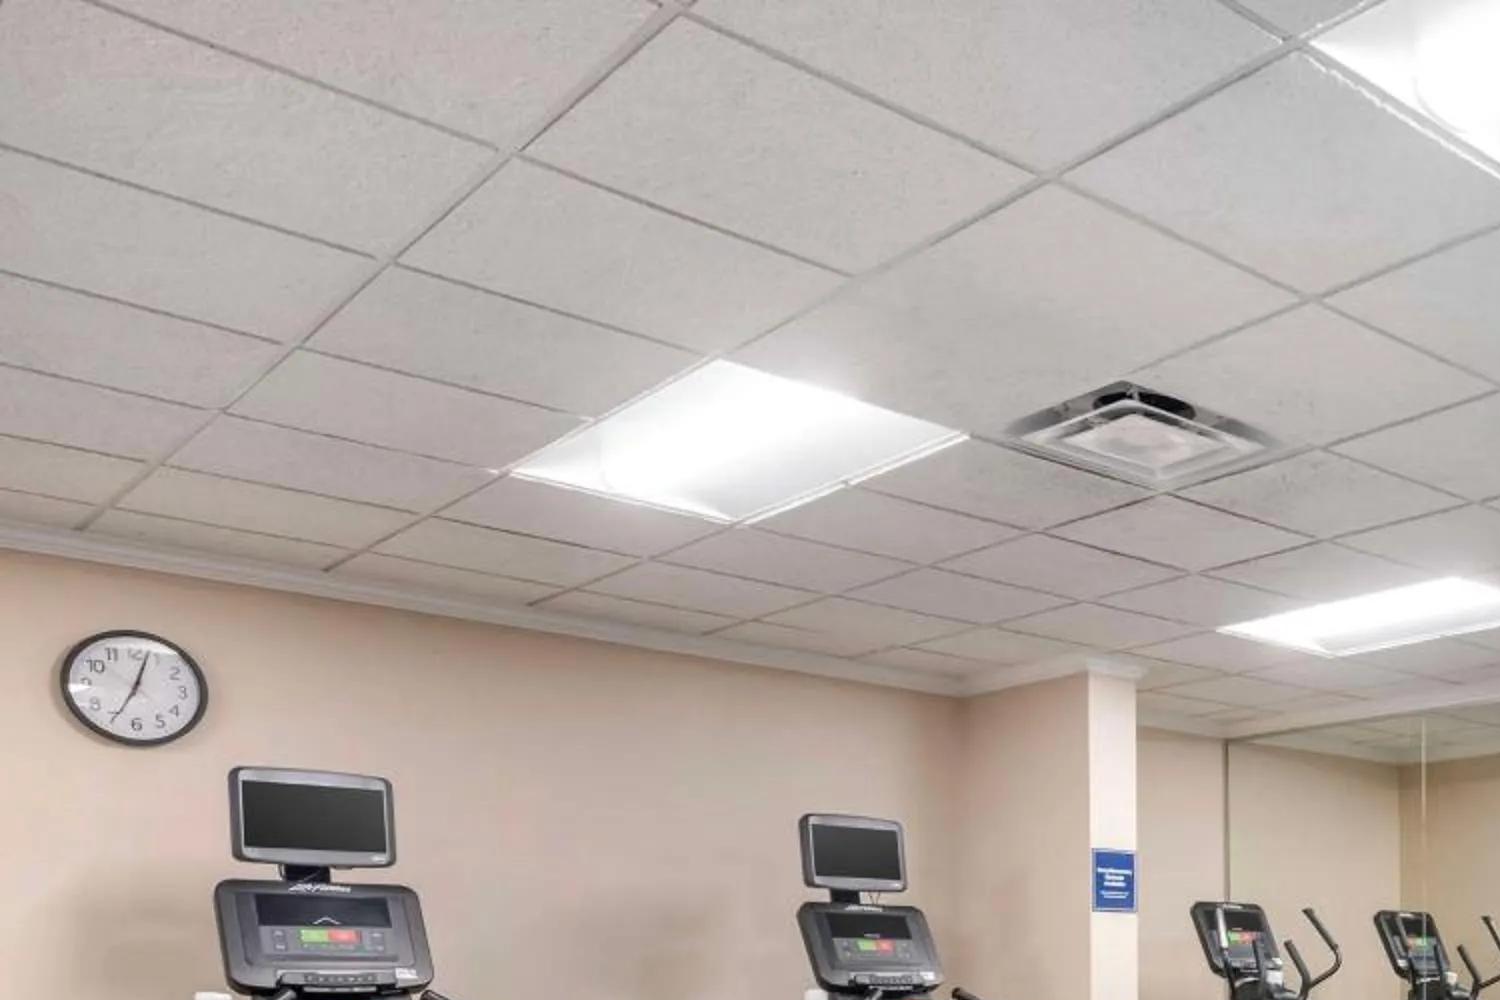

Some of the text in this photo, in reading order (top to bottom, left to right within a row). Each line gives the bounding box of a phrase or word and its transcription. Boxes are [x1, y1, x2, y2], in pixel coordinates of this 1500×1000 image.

[105, 647, 119, 661] 11
[85, 659, 105, 674] 10
[169, 667, 180, 680] 2
[178, 685, 188, 700] 3
[169, 705, 180, 718] 4
[131, 717, 143, 731] 6
[155, 714, 166, 728] 5
